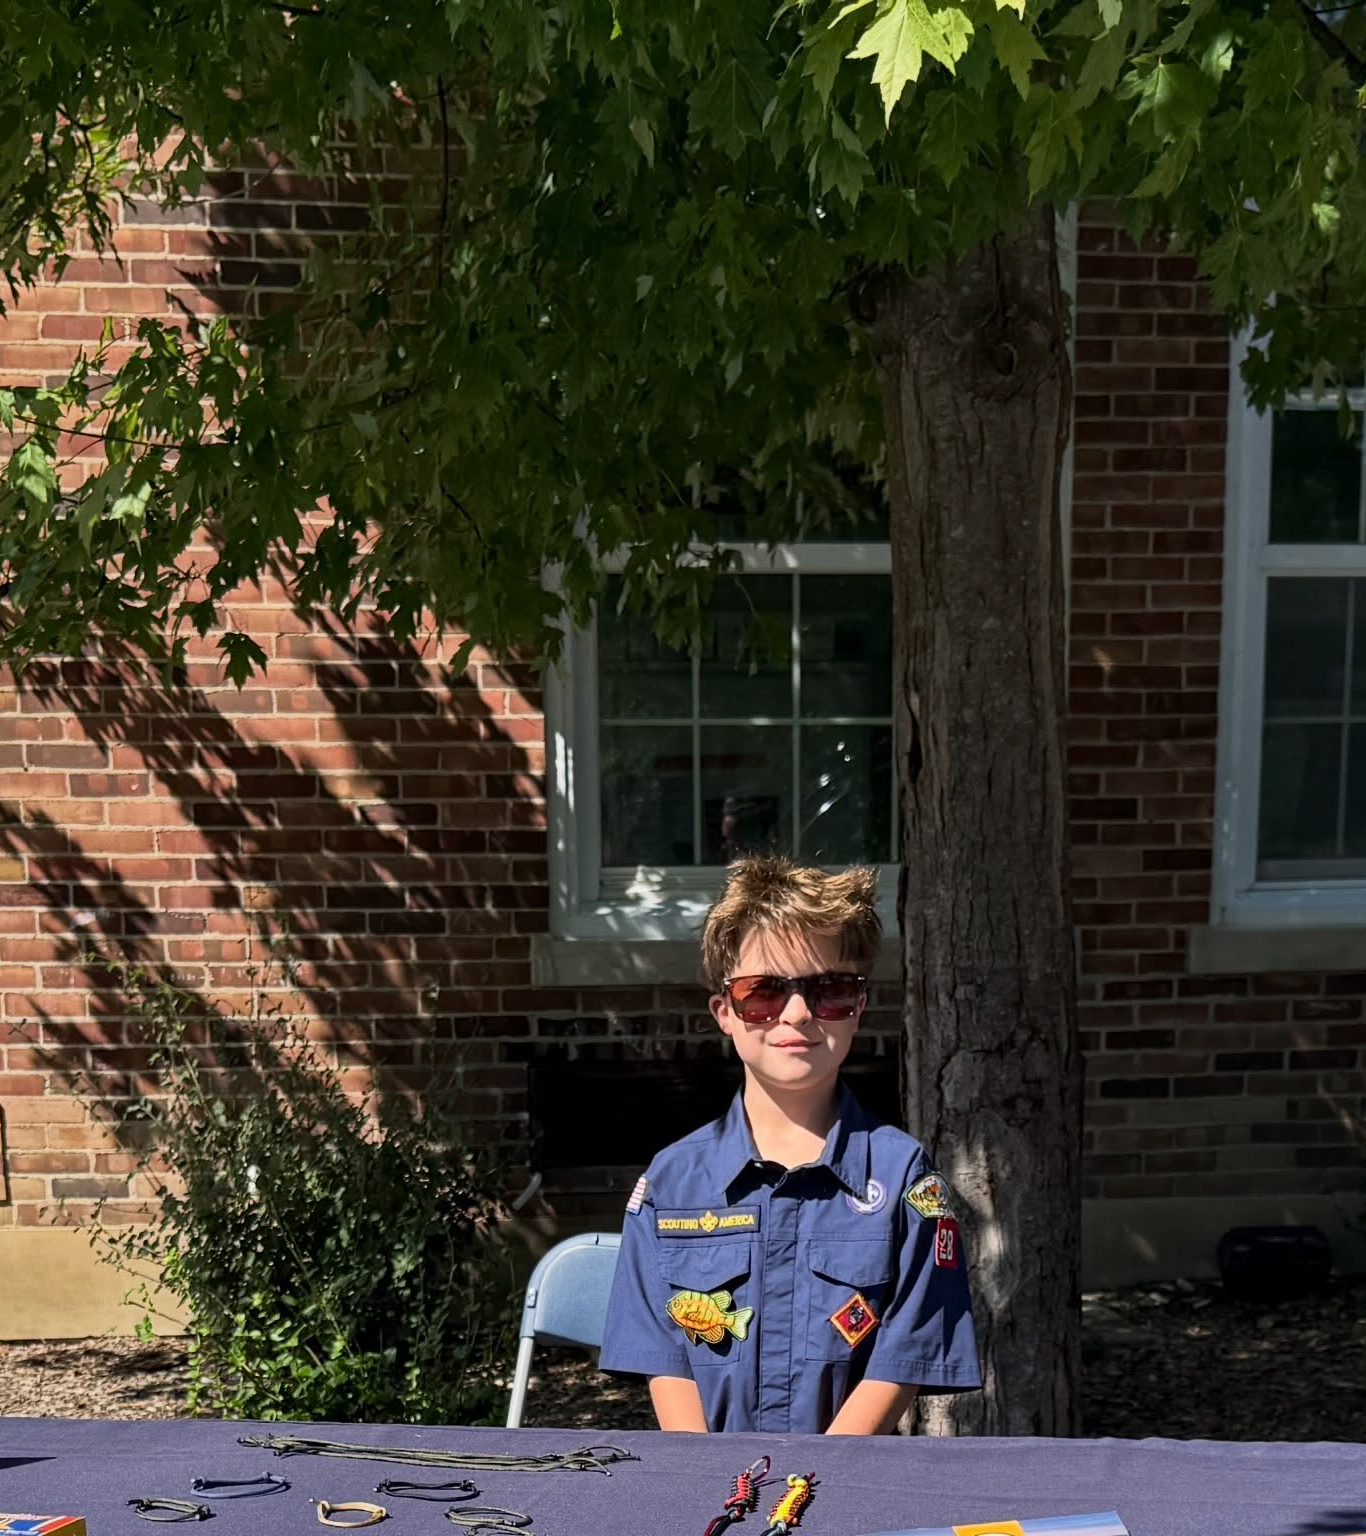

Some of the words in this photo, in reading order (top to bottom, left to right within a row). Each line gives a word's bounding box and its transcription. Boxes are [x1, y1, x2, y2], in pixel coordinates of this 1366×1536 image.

[657, 1218, 699, 1230] SCOUTING
[718, 1214, 754, 1228] AMERICA
[939, 1228, 954, 1260] 28
